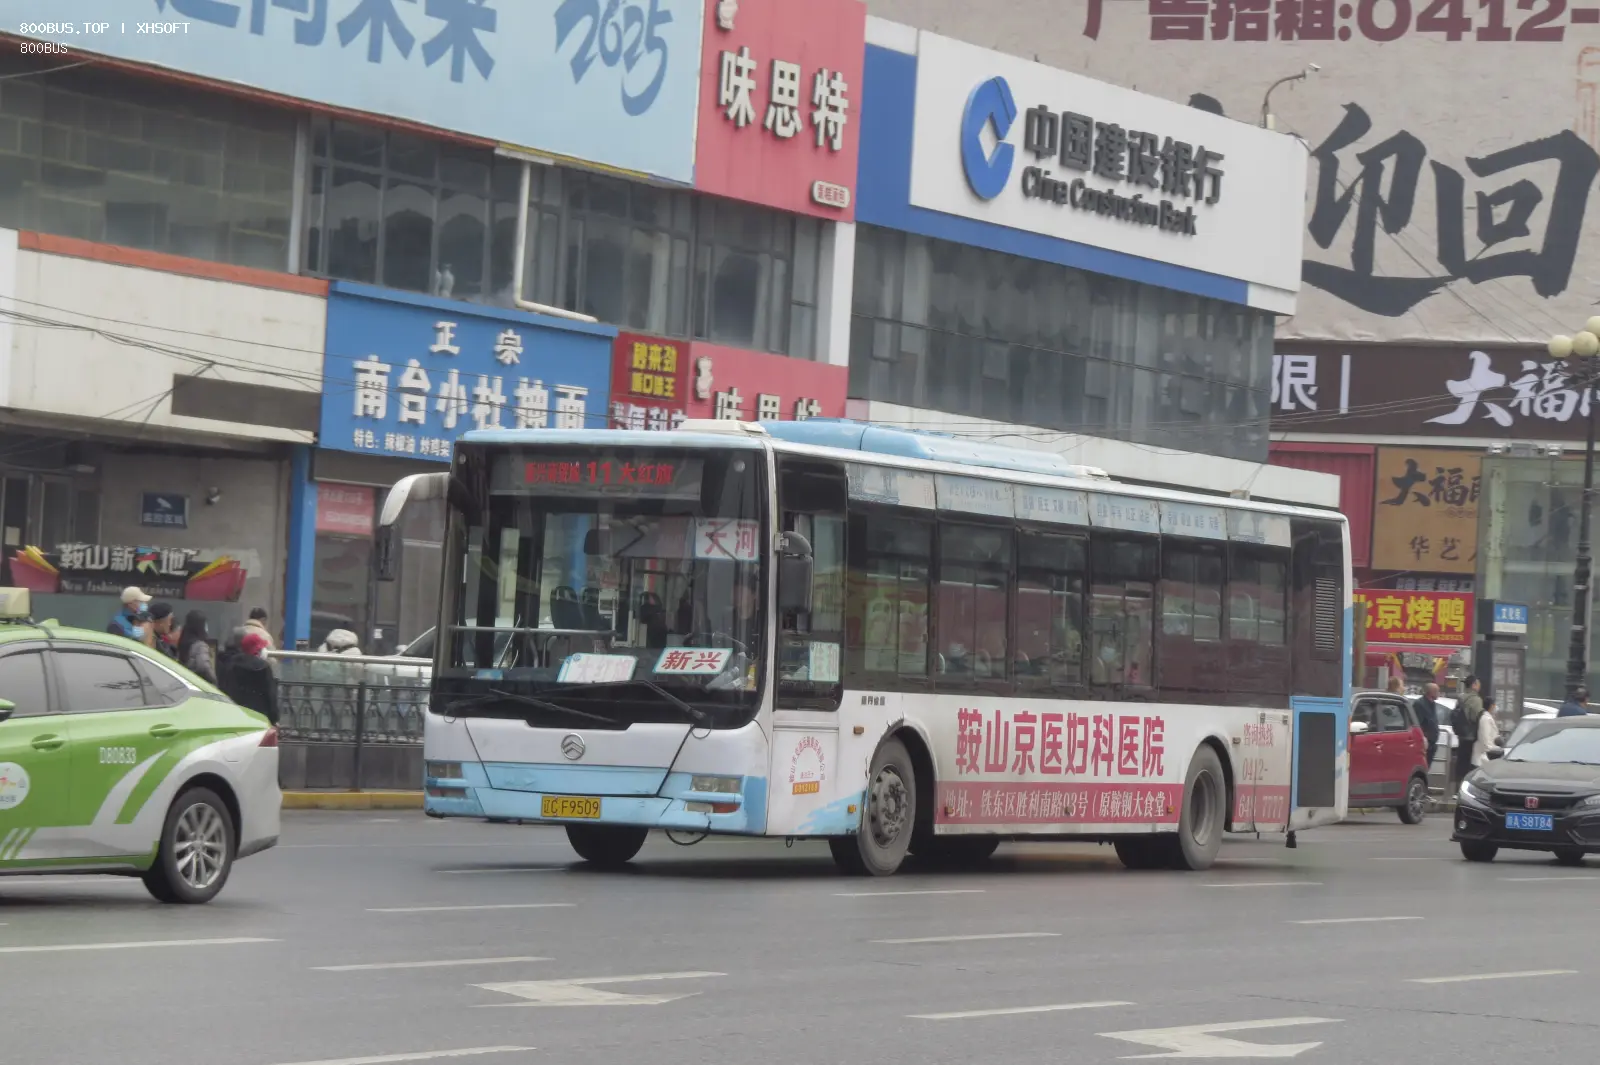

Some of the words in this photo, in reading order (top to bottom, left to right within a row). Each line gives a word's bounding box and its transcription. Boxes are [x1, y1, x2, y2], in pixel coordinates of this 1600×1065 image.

[555, 0, 673, 116] 2025
[717, 46, 849, 152] 味思特
[1024, 104, 1225, 204] 中国建设银行
[1021, 165, 1069, 205] China
[1069, 178, 1159, 226] Construction
[1159, 200, 1198, 235] Bank
[429, 321, 523, 364] 正宗
[1422, 350, 1600, 427] 大福
[587, 460, 613, 485] 11
[618, 461, 675, 485] 大红旗
[704, 520, 758, 558] 天河
[1408, 536, 1477, 562] 华艺
[661, 650, 721, 671] 新兴
[956, 707, 1165, 778] 鞍山京医妇科医院
